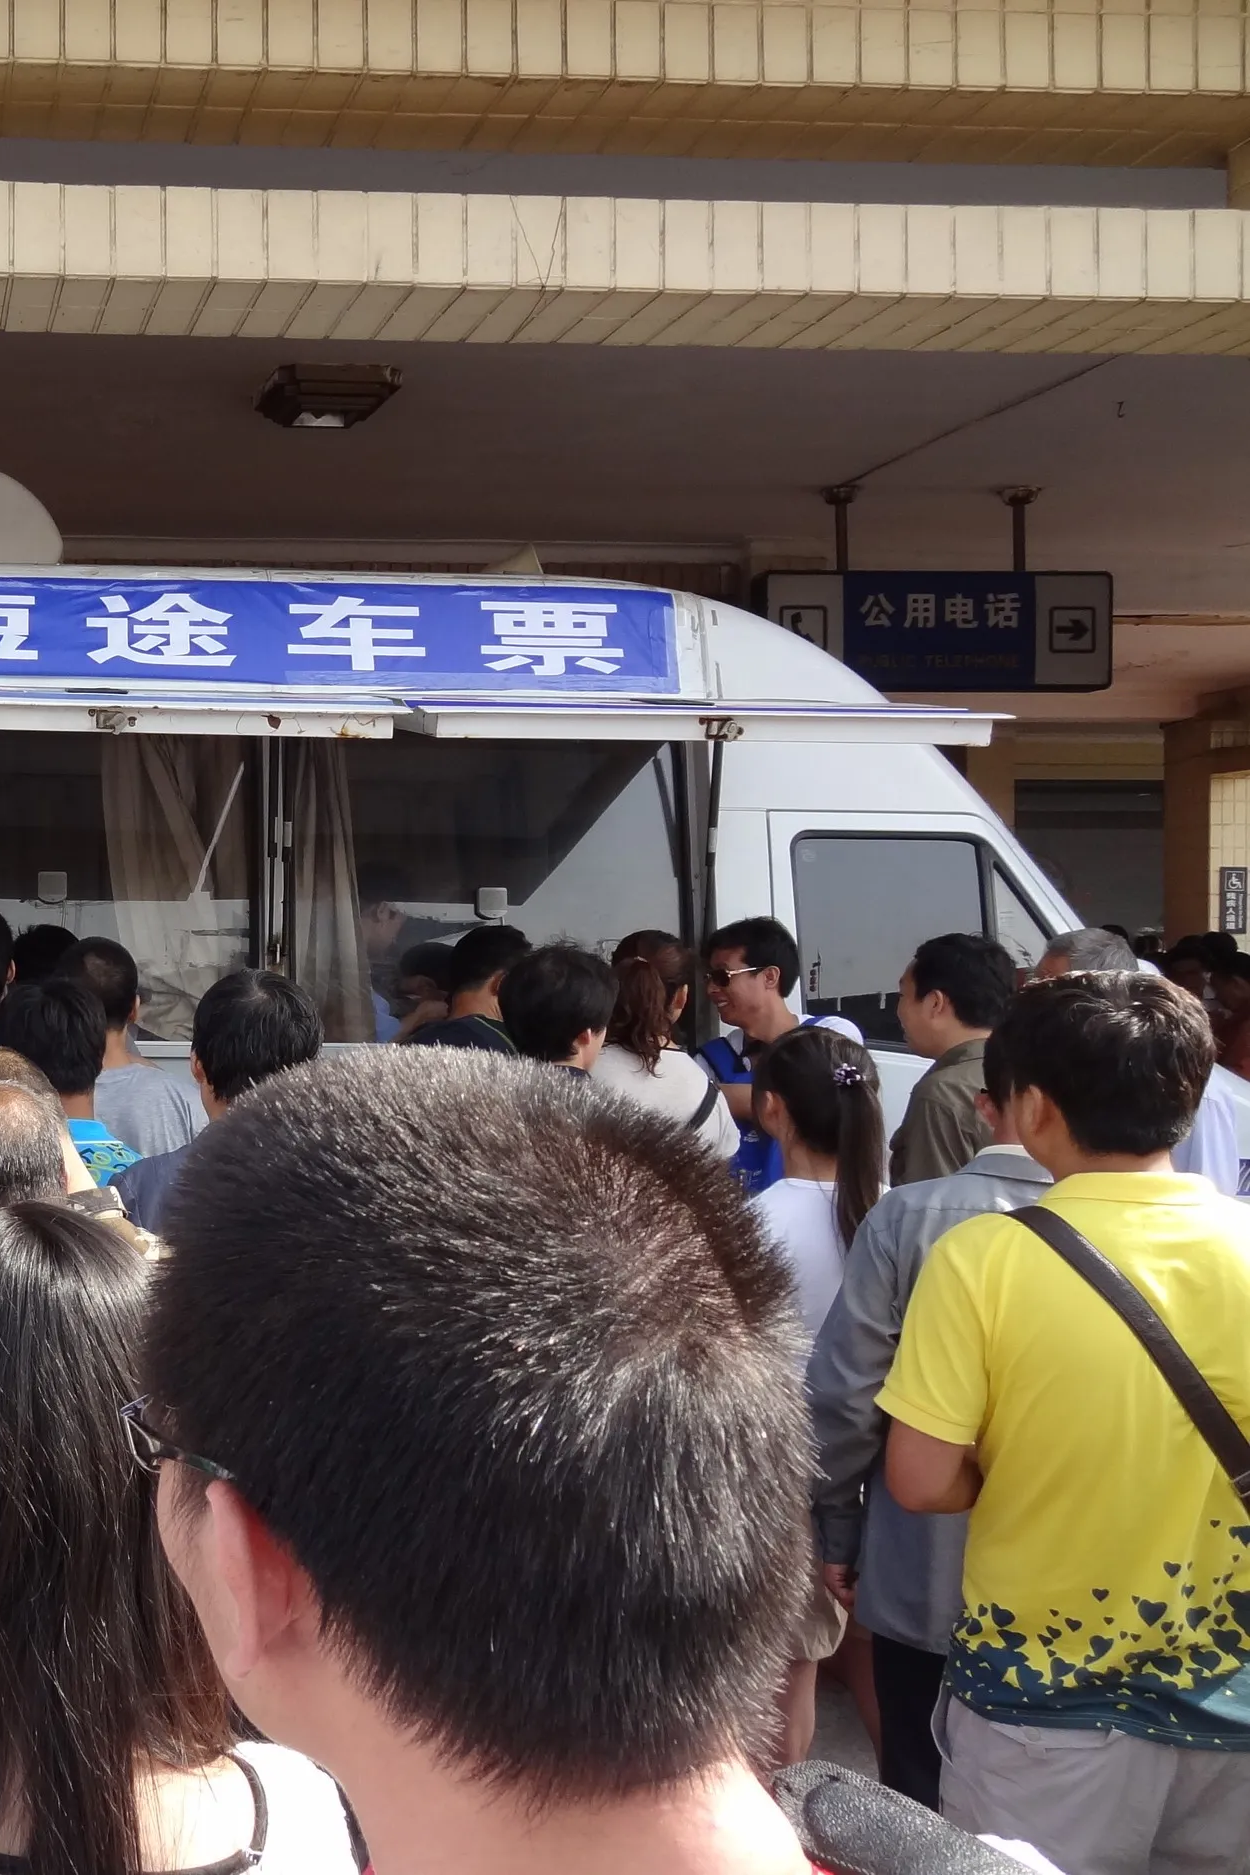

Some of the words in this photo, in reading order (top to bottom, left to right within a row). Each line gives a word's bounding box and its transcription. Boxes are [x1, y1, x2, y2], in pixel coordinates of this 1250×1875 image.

[860, 593, 1021, 628] 公用电话
[858, 653, 917, 668] PUBLIC
[924, 653, 1020, 668] TELEPHONE
